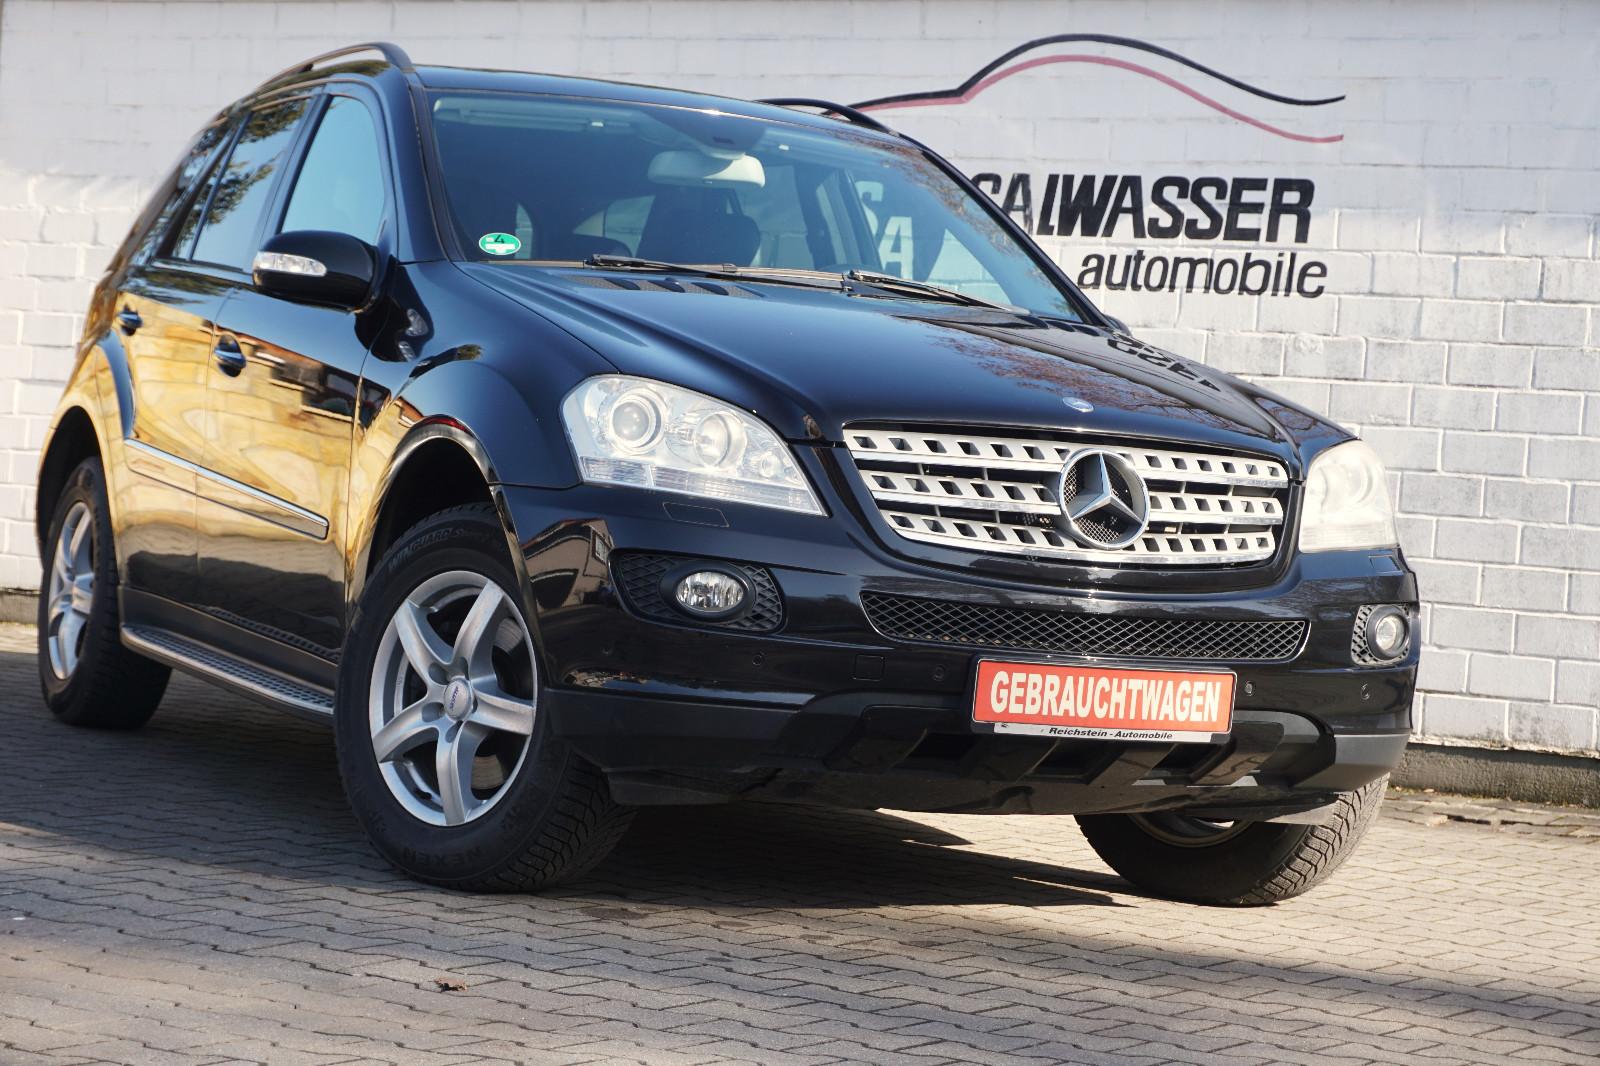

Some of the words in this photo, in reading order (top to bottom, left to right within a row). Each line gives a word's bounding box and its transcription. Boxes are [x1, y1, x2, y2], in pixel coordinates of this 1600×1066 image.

[494, 234, 505, 244] 4
[1077, 250, 1328, 298] automobile
[991, 671, 1221, 722] GEBRAUCHTWAGEN
